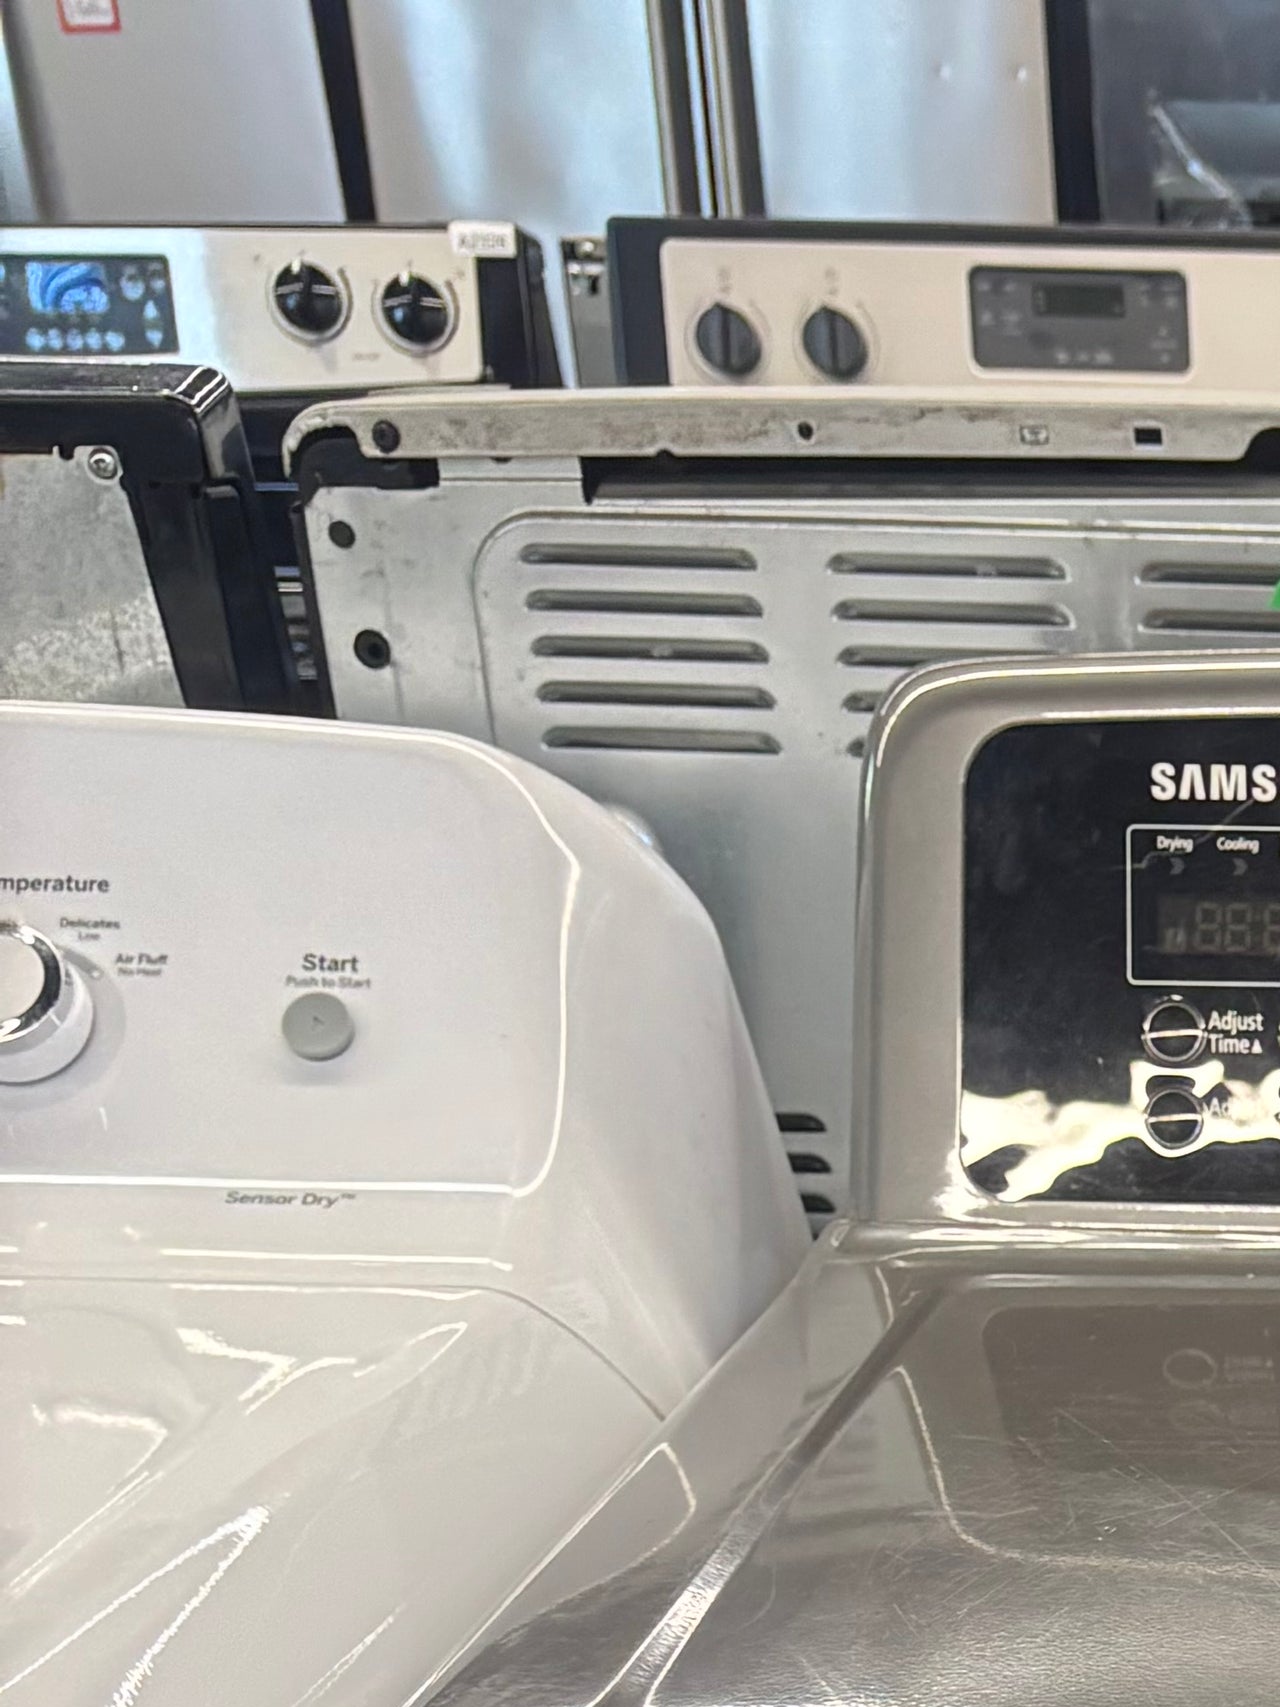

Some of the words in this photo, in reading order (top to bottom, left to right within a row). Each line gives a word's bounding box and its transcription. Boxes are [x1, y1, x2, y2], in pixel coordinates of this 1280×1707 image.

[1156, 835, 1194, 853] Drying
[1216, 836, 1260, 854] Cooling
[60, 917, 121, 930] Delicates
[115, 953, 133, 965] Air
[302, 953, 359, 972] Start
[285, 975, 318, 988] Push
[321, 976, 336, 988] to
[338, 976, 371, 989] Start
[1208, 1011, 1264, 1035] Adjust
[1209, 1035, 1249, 1054] Time
[225, 1191, 298, 1205] Sensor
